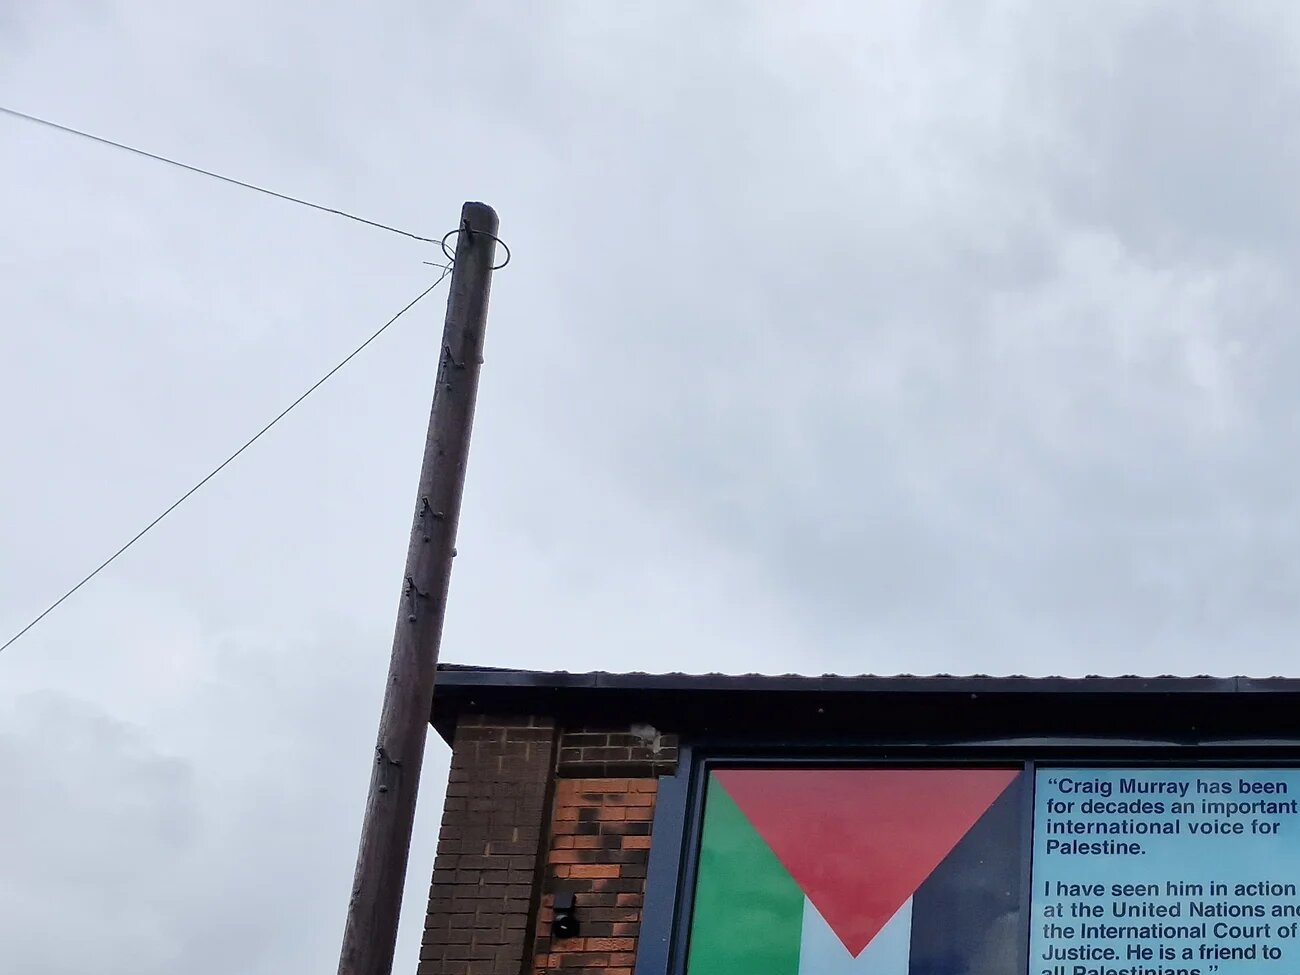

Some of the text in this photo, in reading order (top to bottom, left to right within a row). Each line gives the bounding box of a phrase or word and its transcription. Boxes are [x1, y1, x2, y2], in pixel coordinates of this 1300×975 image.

[1048, 778, 1287, 797] “Craig Murray has been
[1047, 798, 1297, 817] for decades an important
[1047, 819, 1280, 834] international voice for
[1047, 840, 1145, 855] Palestine.
[1045, 881, 1295, 896] I have seen him in action
[1044, 903, 1063, 917] at
[1071, 902, 1104, 917] the
[1113, 902, 1180, 917] United
[1190, 902, 1265, 917] Nations
[1043, 923, 1297, 939] the International Court of
[1042, 944, 1281, 960] Justice. He is a friend to
